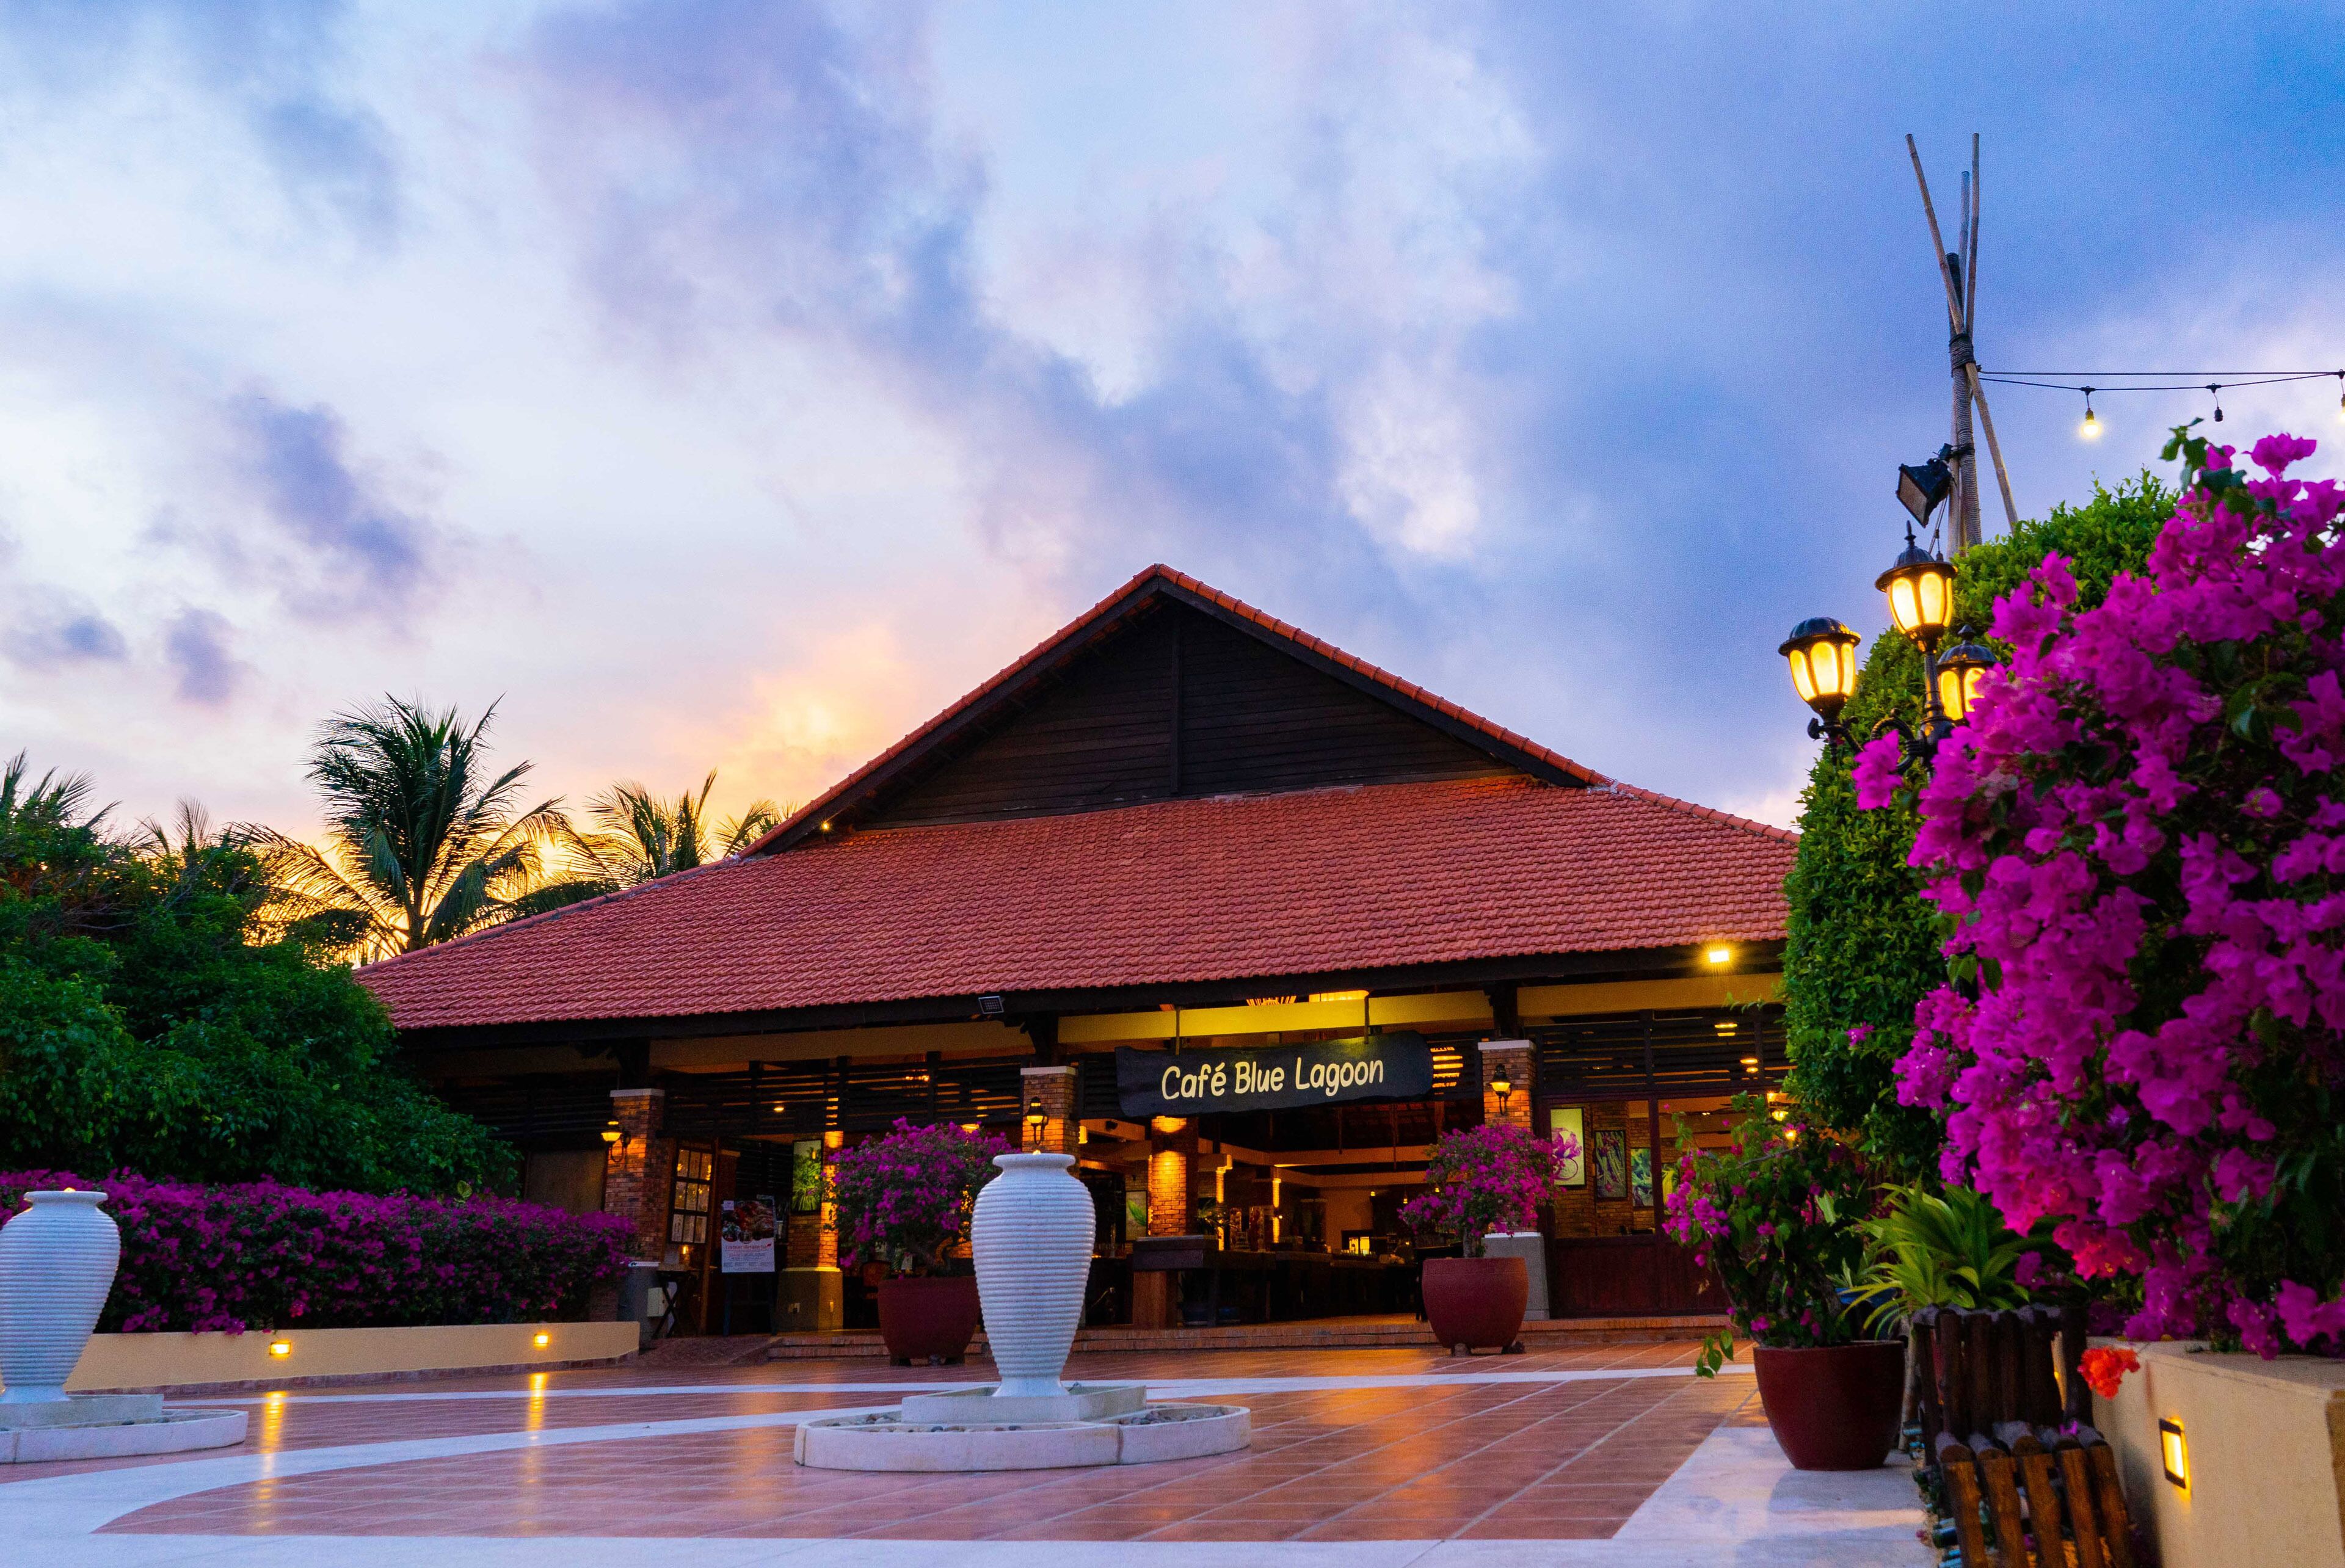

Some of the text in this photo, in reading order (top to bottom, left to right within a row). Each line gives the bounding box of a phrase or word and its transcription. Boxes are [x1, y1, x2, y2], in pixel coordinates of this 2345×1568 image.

[1162, 1057, 1384, 1100] Café Blue Lagoon
